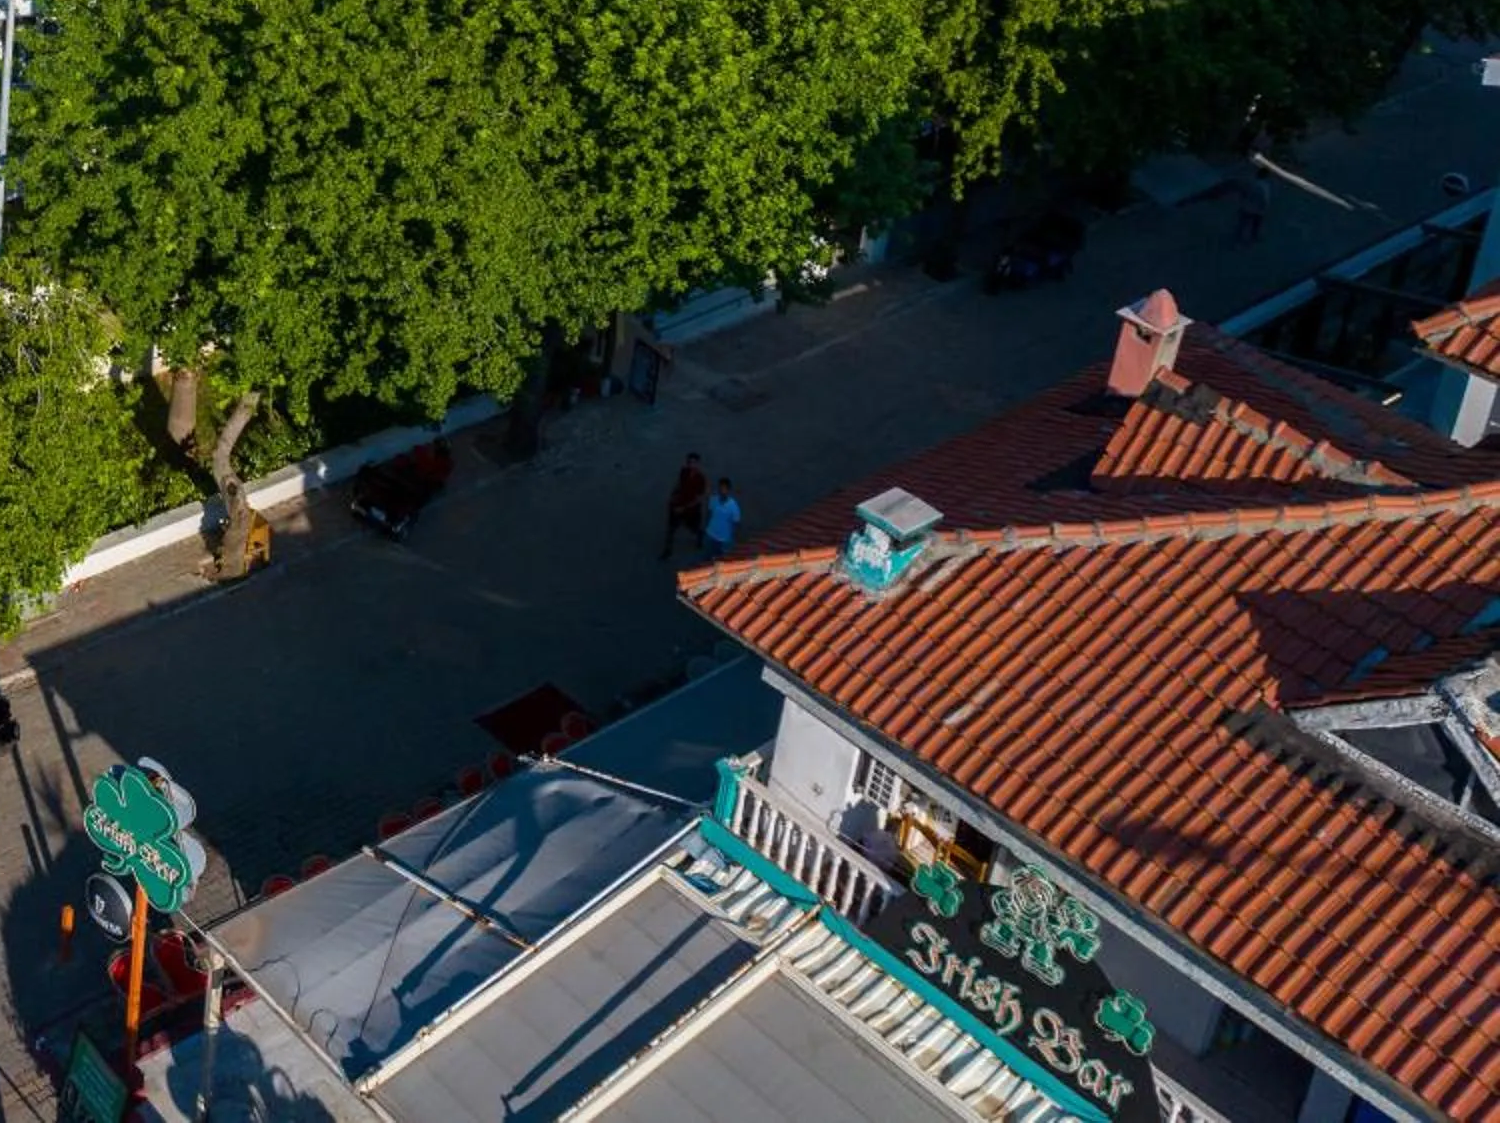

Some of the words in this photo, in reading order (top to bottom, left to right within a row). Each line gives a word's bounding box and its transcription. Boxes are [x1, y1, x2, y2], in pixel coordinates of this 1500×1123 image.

[140, 843, 180, 884] Bar
[905, 922, 1022, 1035] Irish
[1028, 1007, 1135, 1113] Bar
